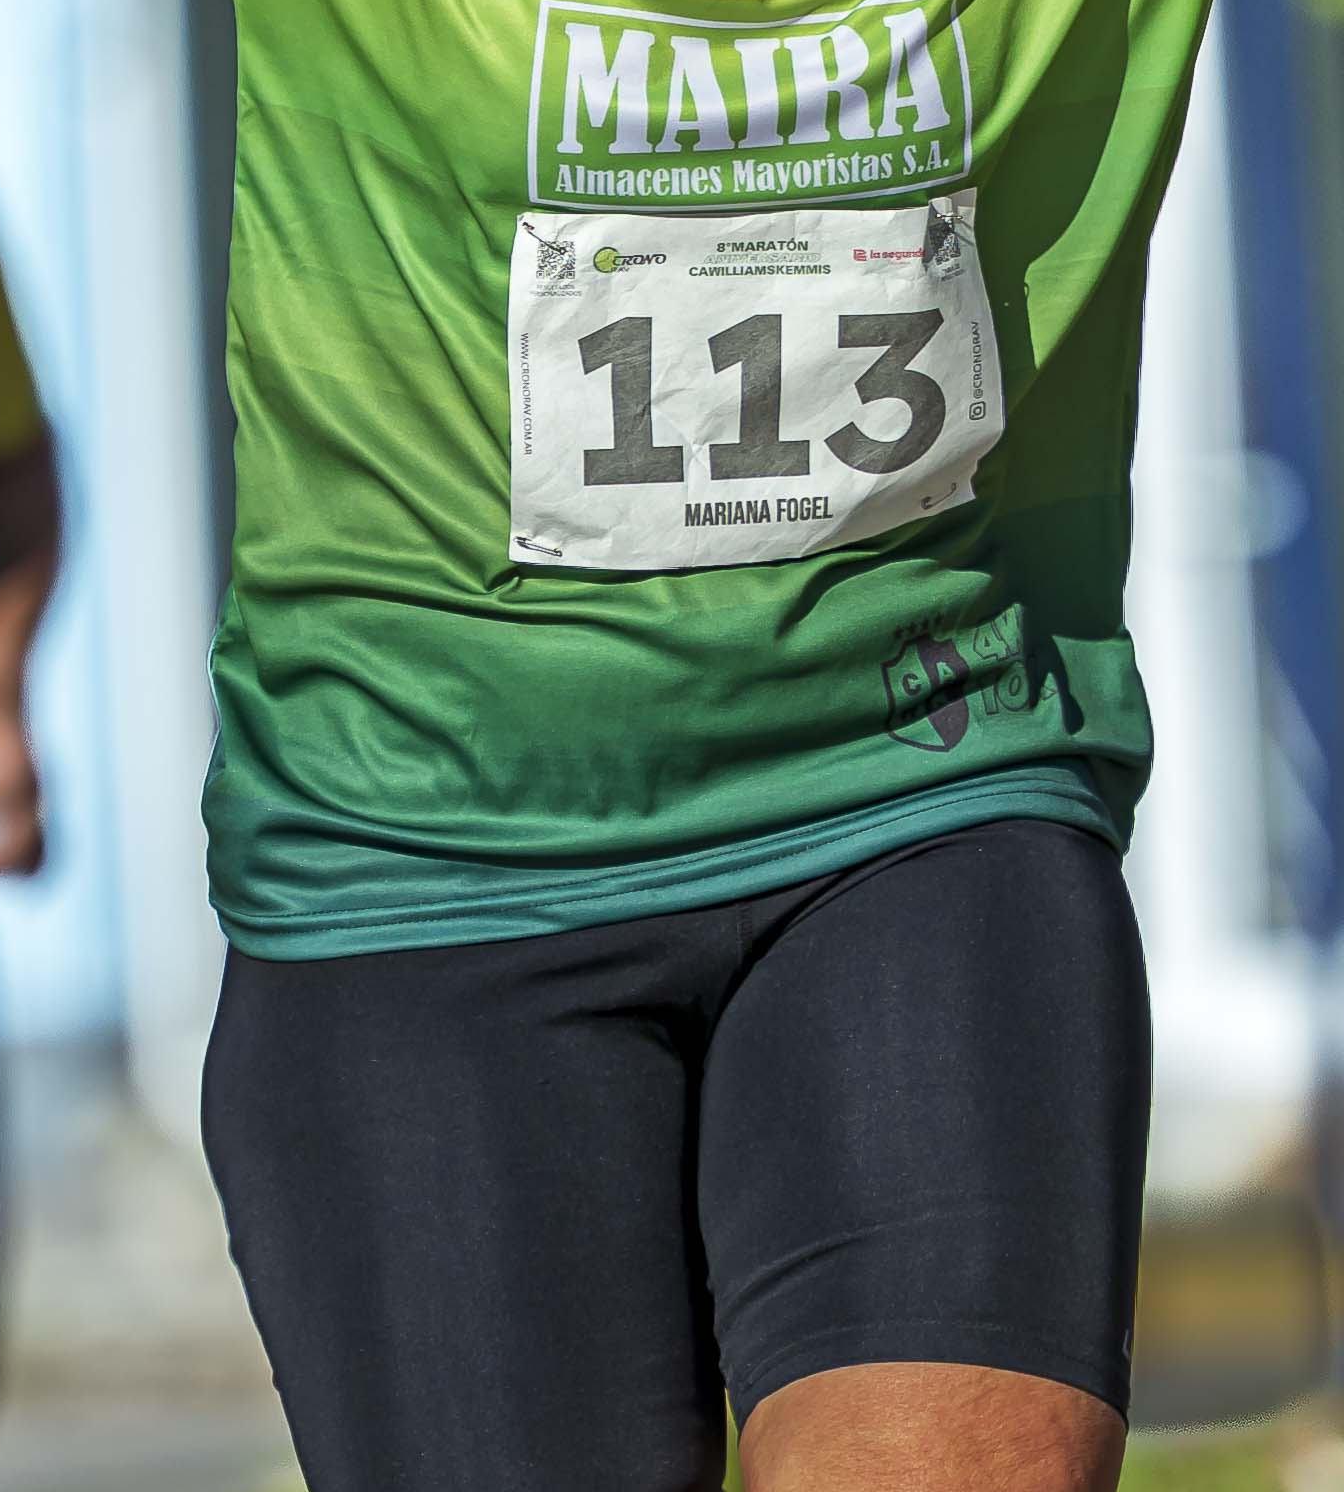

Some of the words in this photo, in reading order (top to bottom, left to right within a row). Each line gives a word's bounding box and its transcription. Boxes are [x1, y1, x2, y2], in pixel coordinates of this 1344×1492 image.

[557, 7, 950, 154] MAIRA
[555, 162, 723, 198] Almacenes
[732, 147, 893, 195] Mayoristas
[903, 139, 951, 178] S.A.
[688, 264, 832, 277] CAWILLIAMSKEMMIS
[577, 308, 947, 486] 113
[684, 497, 771, 527] MARIANA
[776, 496, 833, 522] FOGEL
